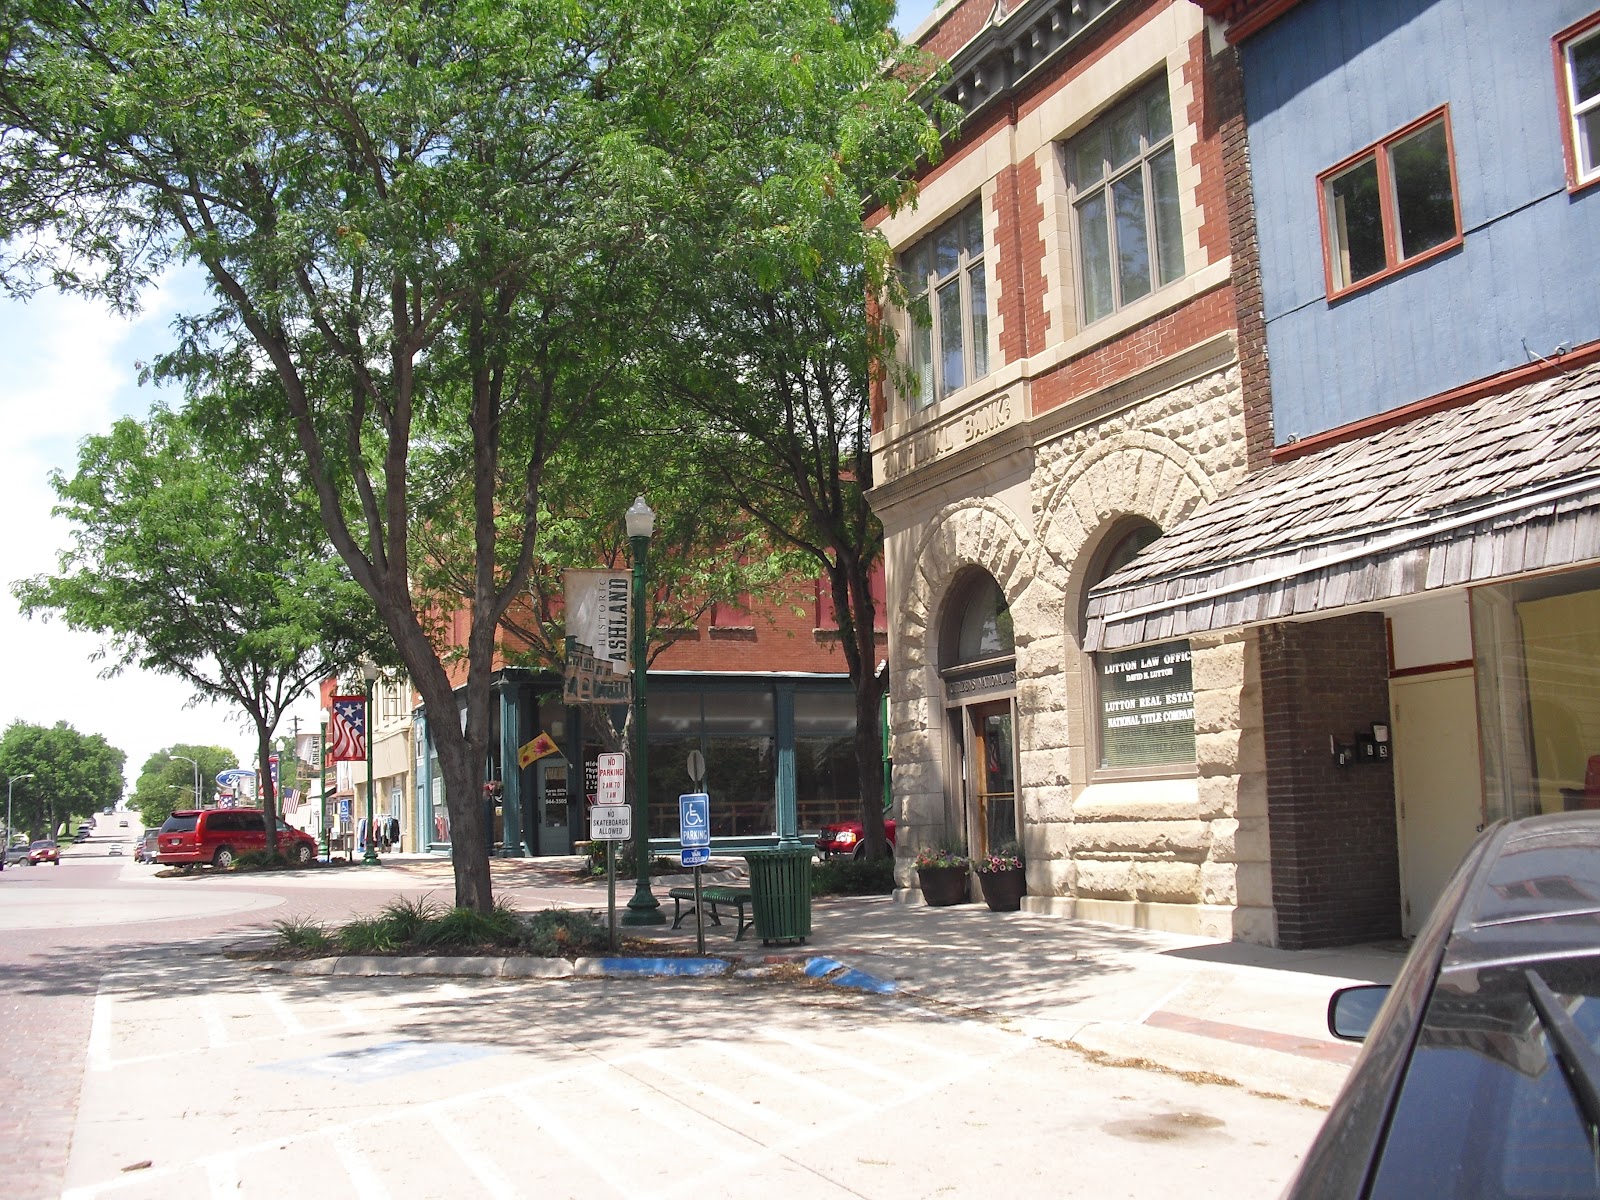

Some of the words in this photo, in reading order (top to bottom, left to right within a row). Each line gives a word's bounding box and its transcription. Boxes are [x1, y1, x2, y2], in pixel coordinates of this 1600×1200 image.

[598, 578, 606, 646] HISTORIC
[608, 578, 628, 662] ASHLAND
[1104, 660, 1137, 675] LUTTON
[1141, 656, 1160, 669] LAW
[1163, 651, 1191, 665] OFFIC
[1126, 672, 1143, 682] DAVID
[1150, 668, 1173, 679] LUTTON
[1105, 698, 1135, 712] LUTTON
[1139, 695, 1162, 708] REAL
[1166, 691, 1194, 705] ESTAT
[1107, 715, 1140, 728] NATIONAL
[1141, 712, 1162, 724] TITLE
[1163, 708, 1195, 722] COMPAN
[607, 758, 616, 766] NO
[600, 768, 623, 776] PARKING
[605, 781, 613, 789] AM
[593, 819, 629, 827] SKATEBOARDS
[598, 827, 623, 835] ALLOWED
[683, 830, 708, 840] PARKING
